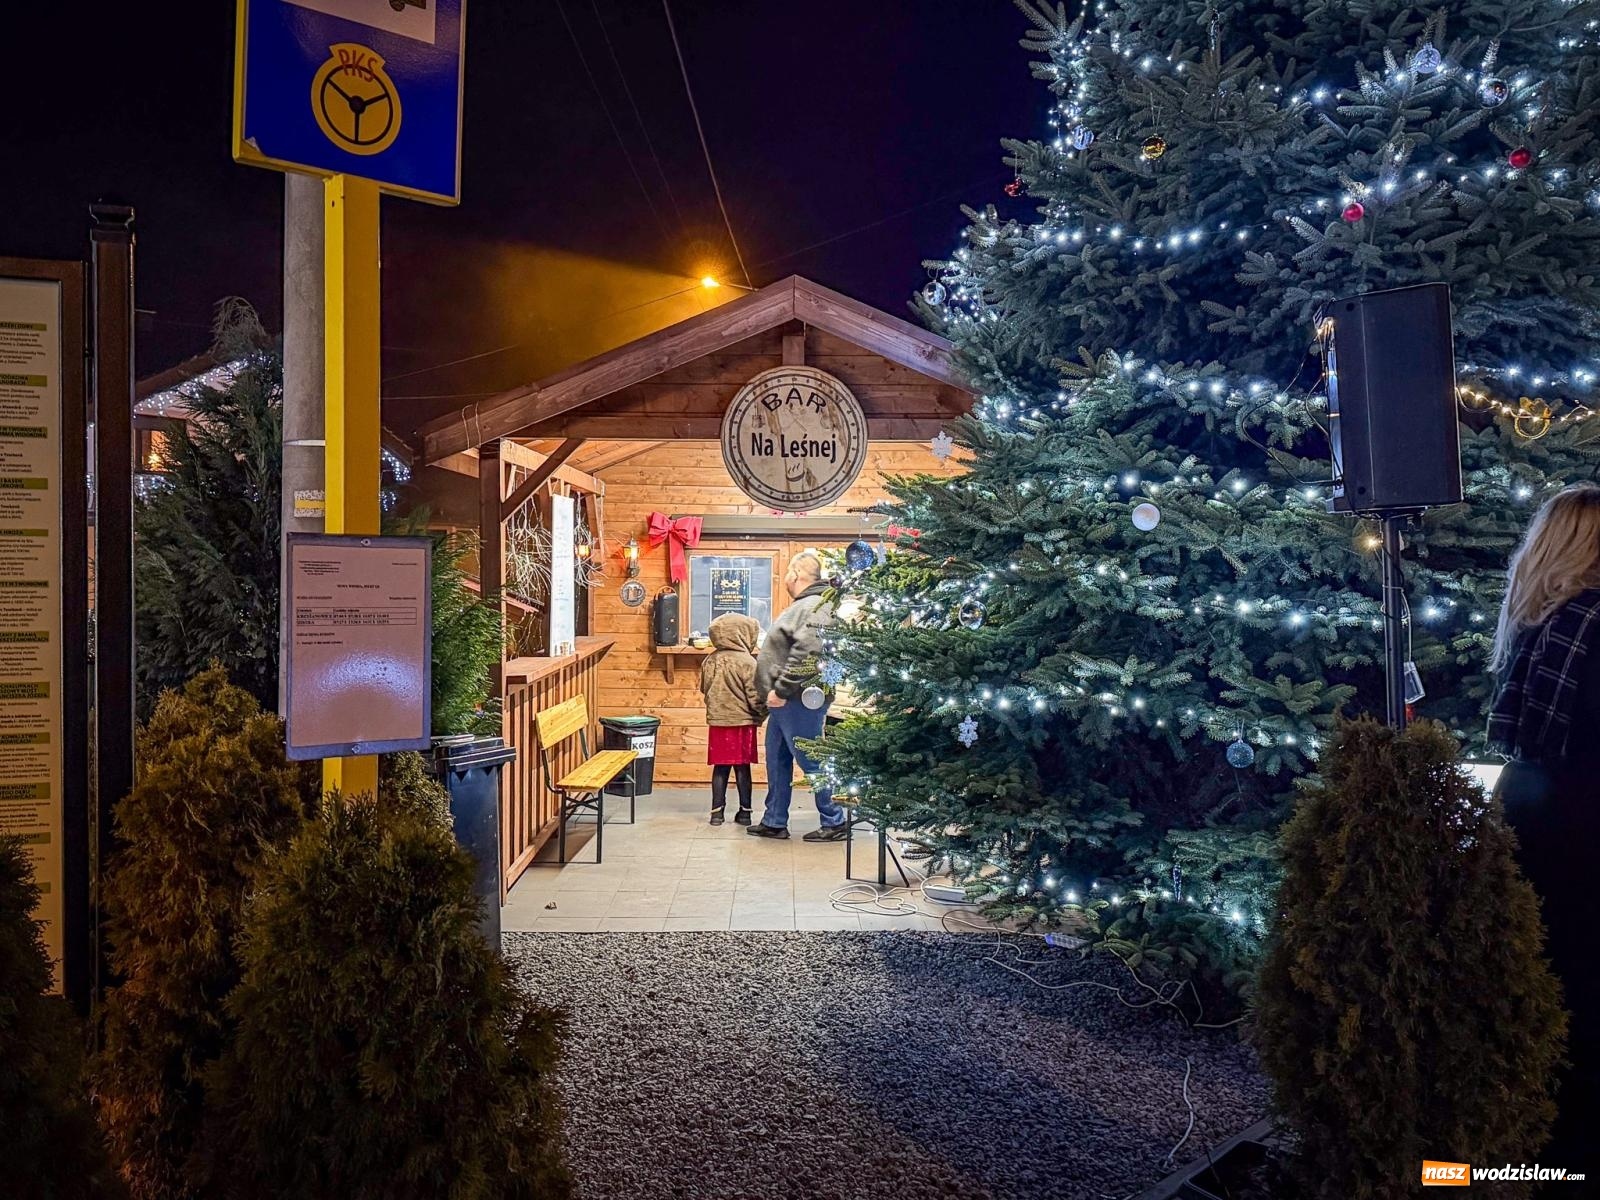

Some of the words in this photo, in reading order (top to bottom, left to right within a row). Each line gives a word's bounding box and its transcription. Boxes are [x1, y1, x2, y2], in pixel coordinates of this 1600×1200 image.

[337, 48, 379, 83] PKS
[761, 387, 827, 414] BAR
[751, 432, 774, 457] Na
[780, 433, 837, 464] Leśnej
[632, 741, 654, 750] KOSZ
